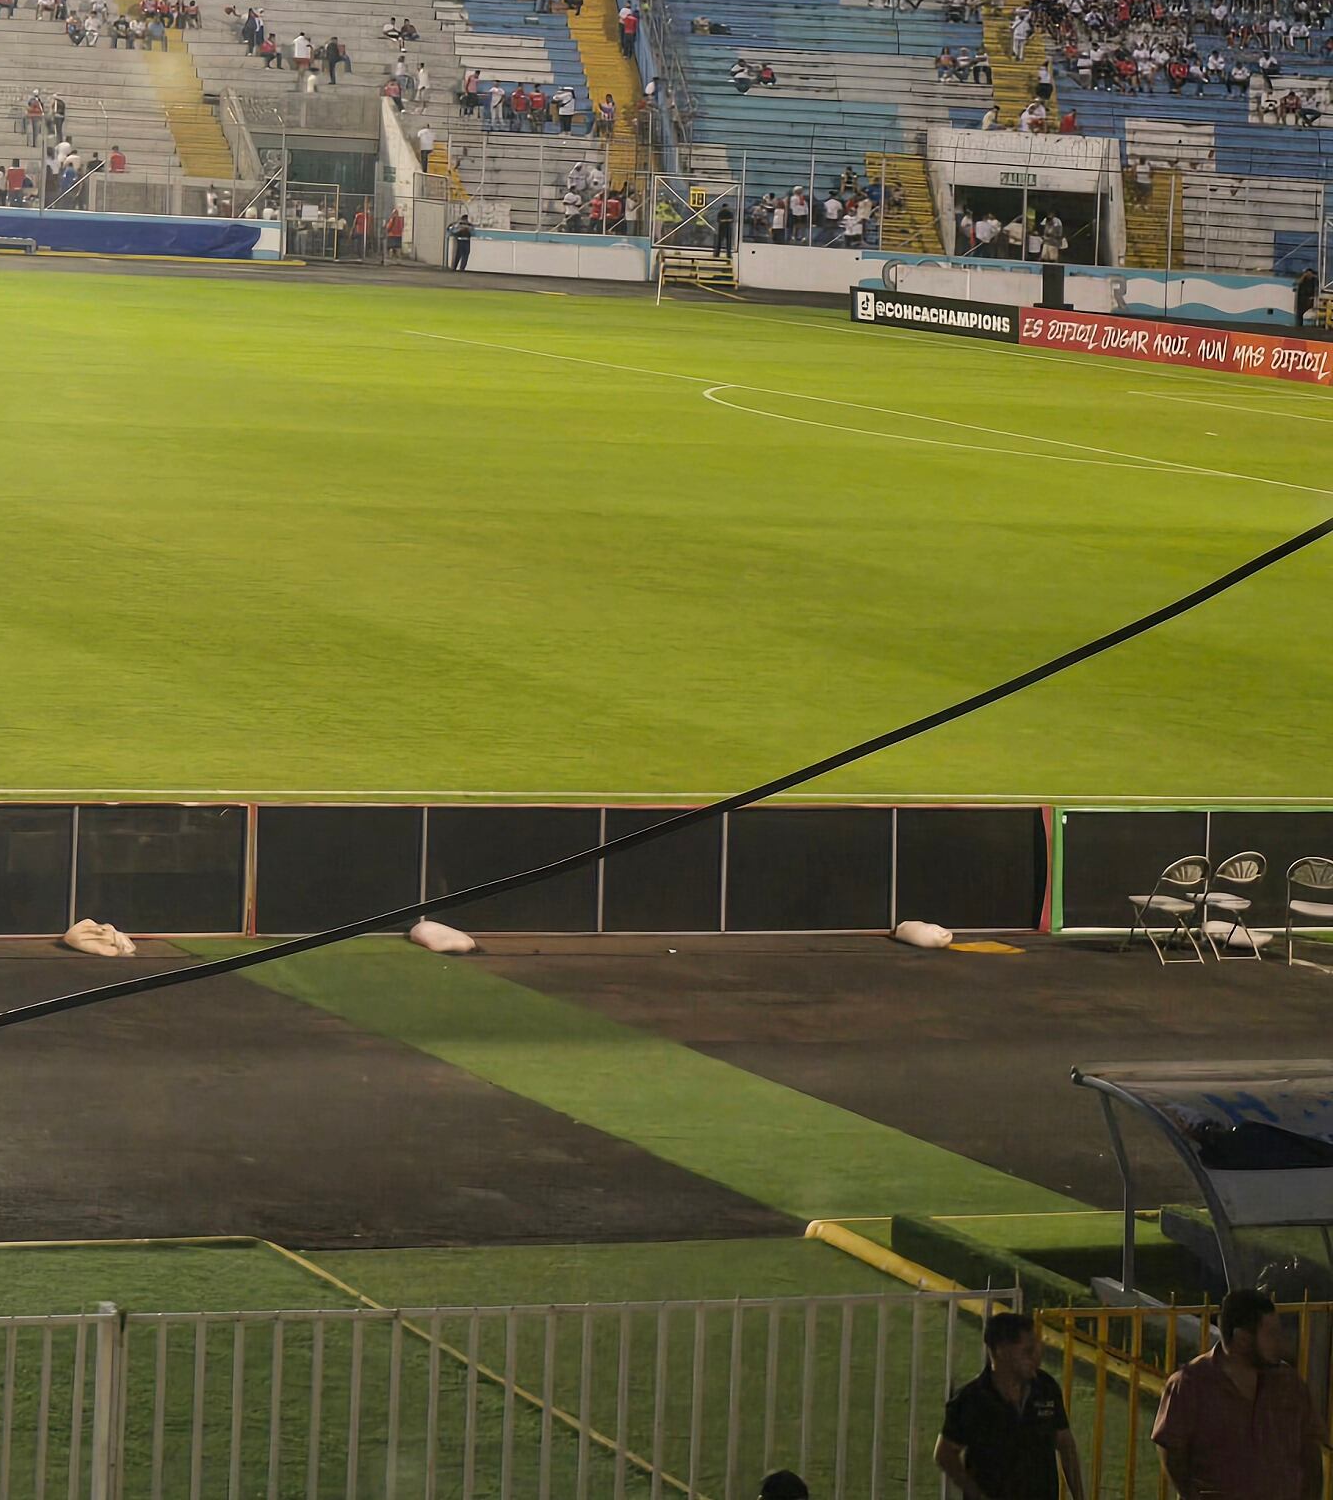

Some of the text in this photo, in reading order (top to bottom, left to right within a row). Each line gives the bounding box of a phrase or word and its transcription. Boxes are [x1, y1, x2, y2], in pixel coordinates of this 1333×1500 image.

[1022, 318, 1044, 338] ES
[1047, 320, 1099, 350] DIFICIL
[1101, 326, 1149, 355] JUGAR
[1153, 333, 1191, 358] AQUI.
[1233, 345, 1265, 371] MAS
[1271, 347, 1331, 380] DIFICIL
